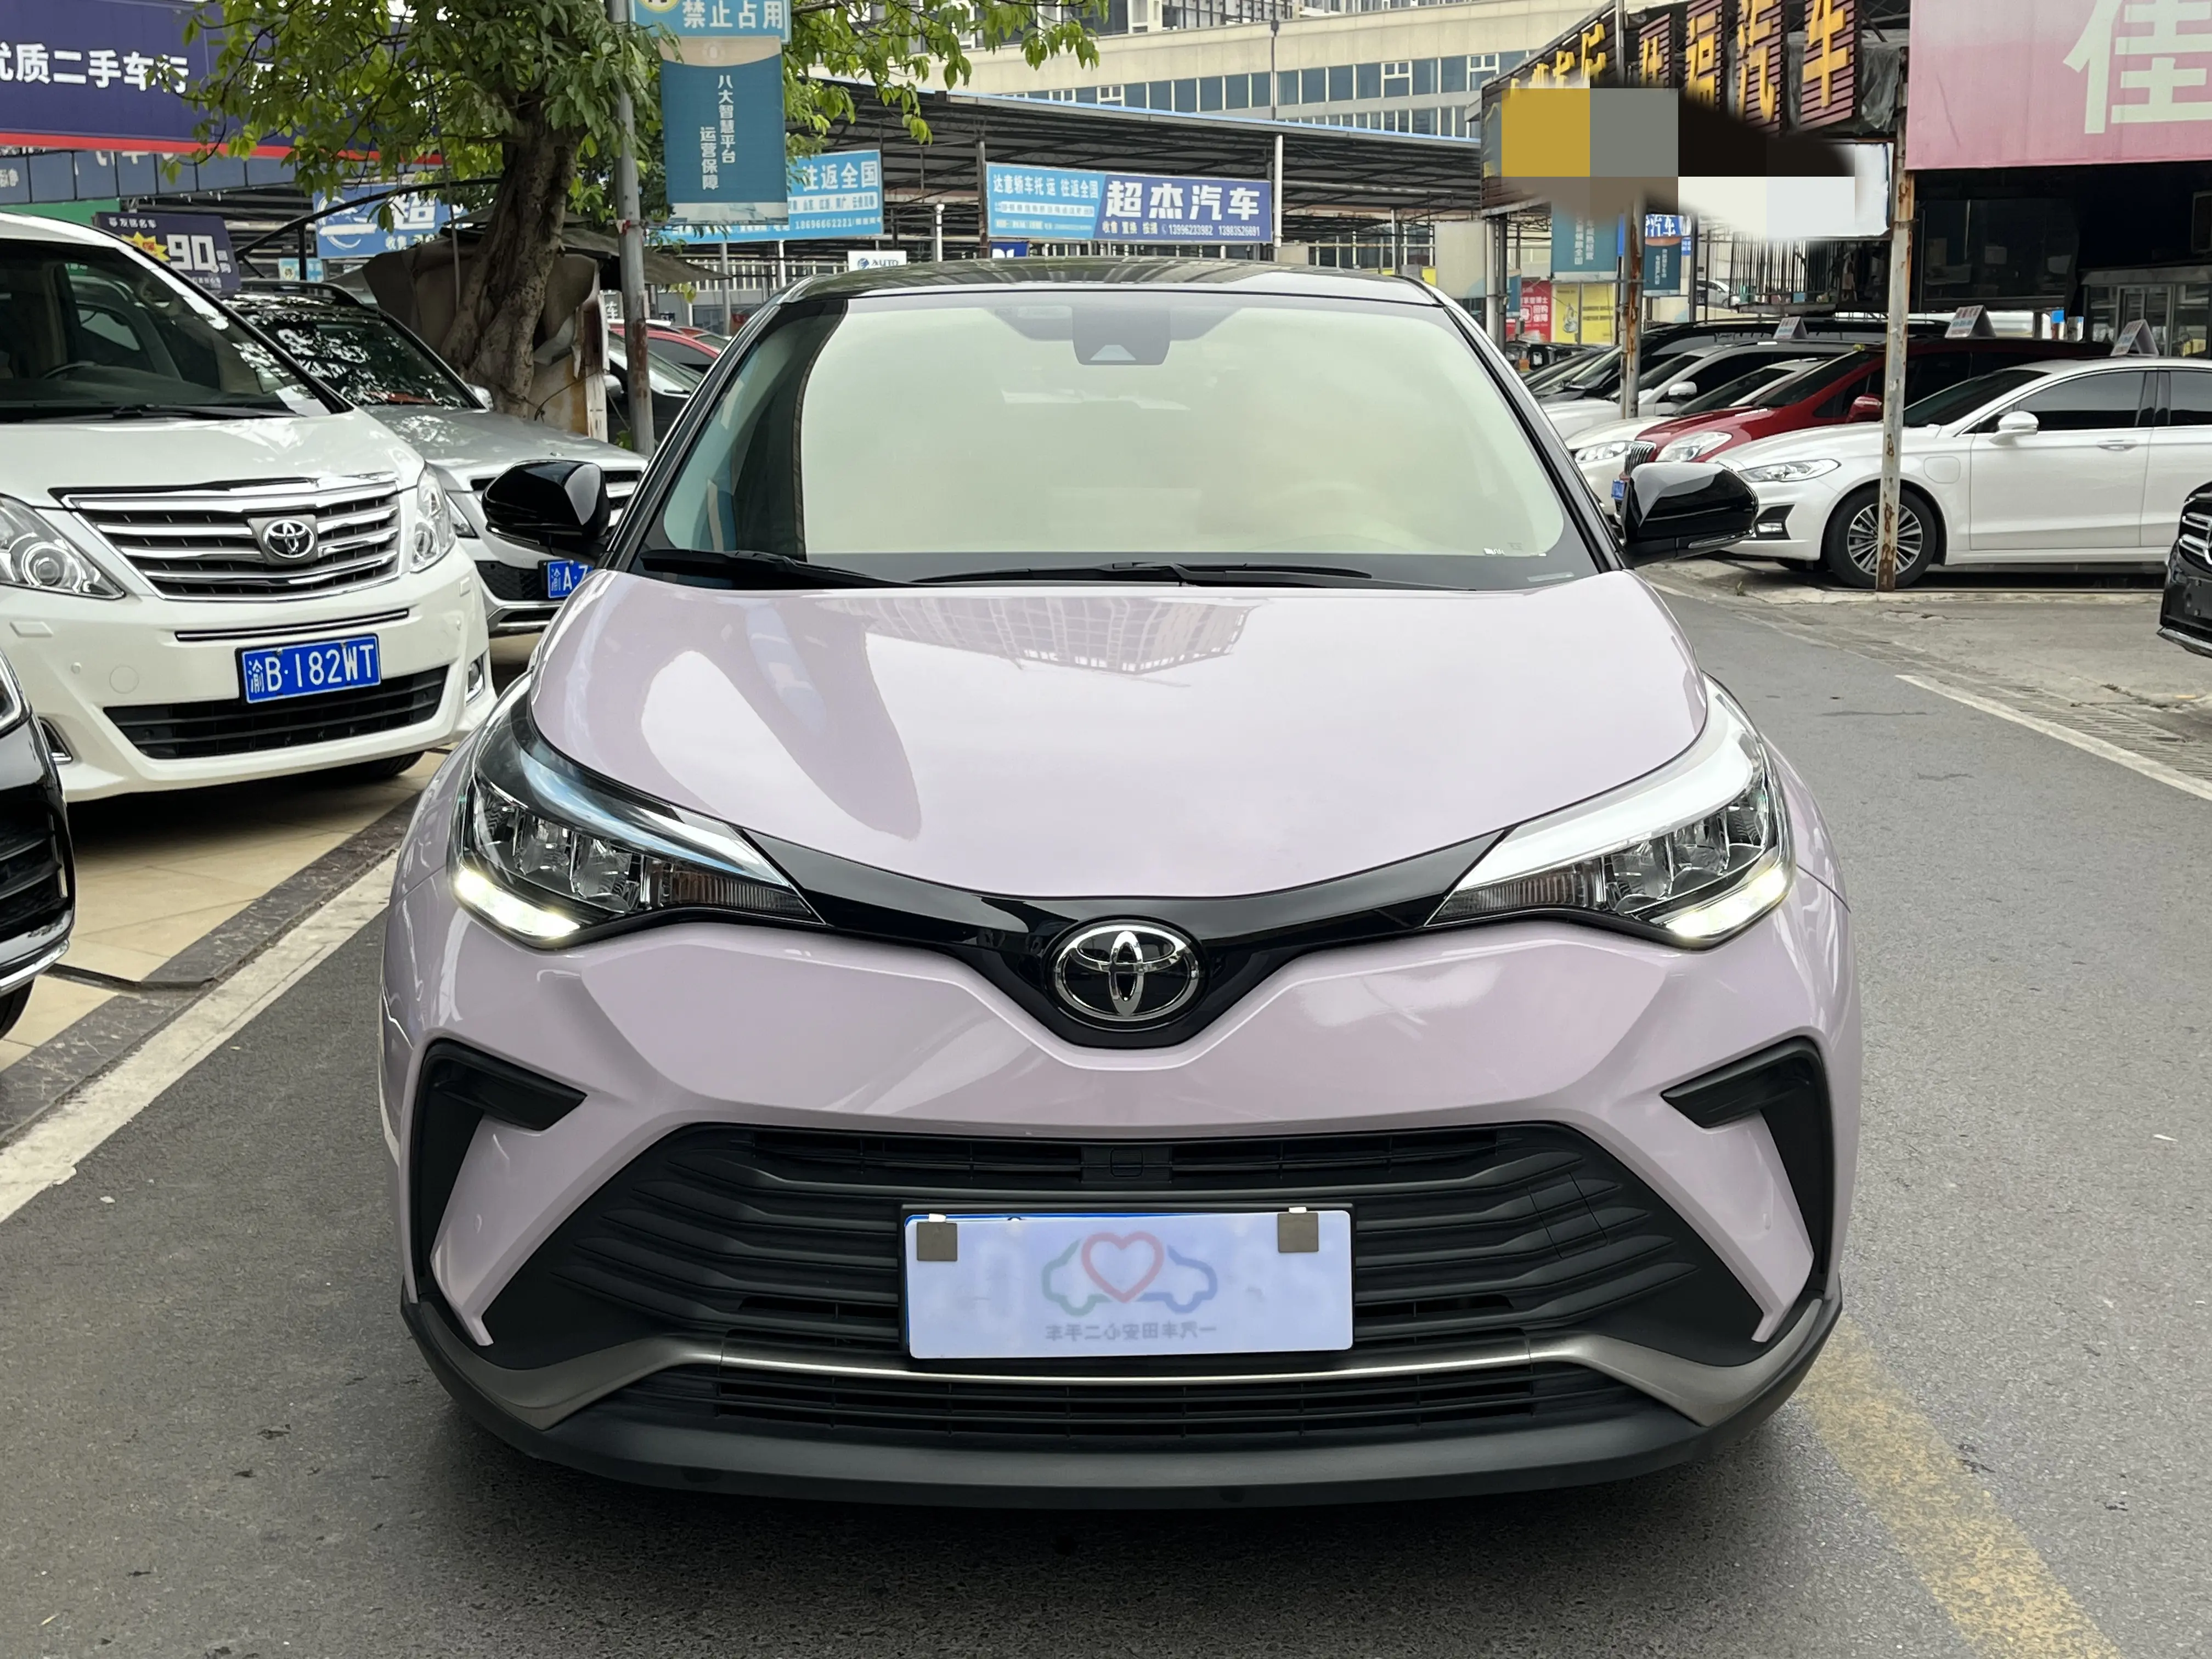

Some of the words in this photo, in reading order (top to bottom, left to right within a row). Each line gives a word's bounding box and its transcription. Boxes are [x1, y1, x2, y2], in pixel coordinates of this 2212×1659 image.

[682, 0, 783, 29] 禁止占用
[2063, 0, 2212, 134] 佳
[718, 75, 736, 163] 八大智慧平台
[699, 127, 719, 190] 运营保障
[1105, 180, 1260, 221] 超杰汽车
